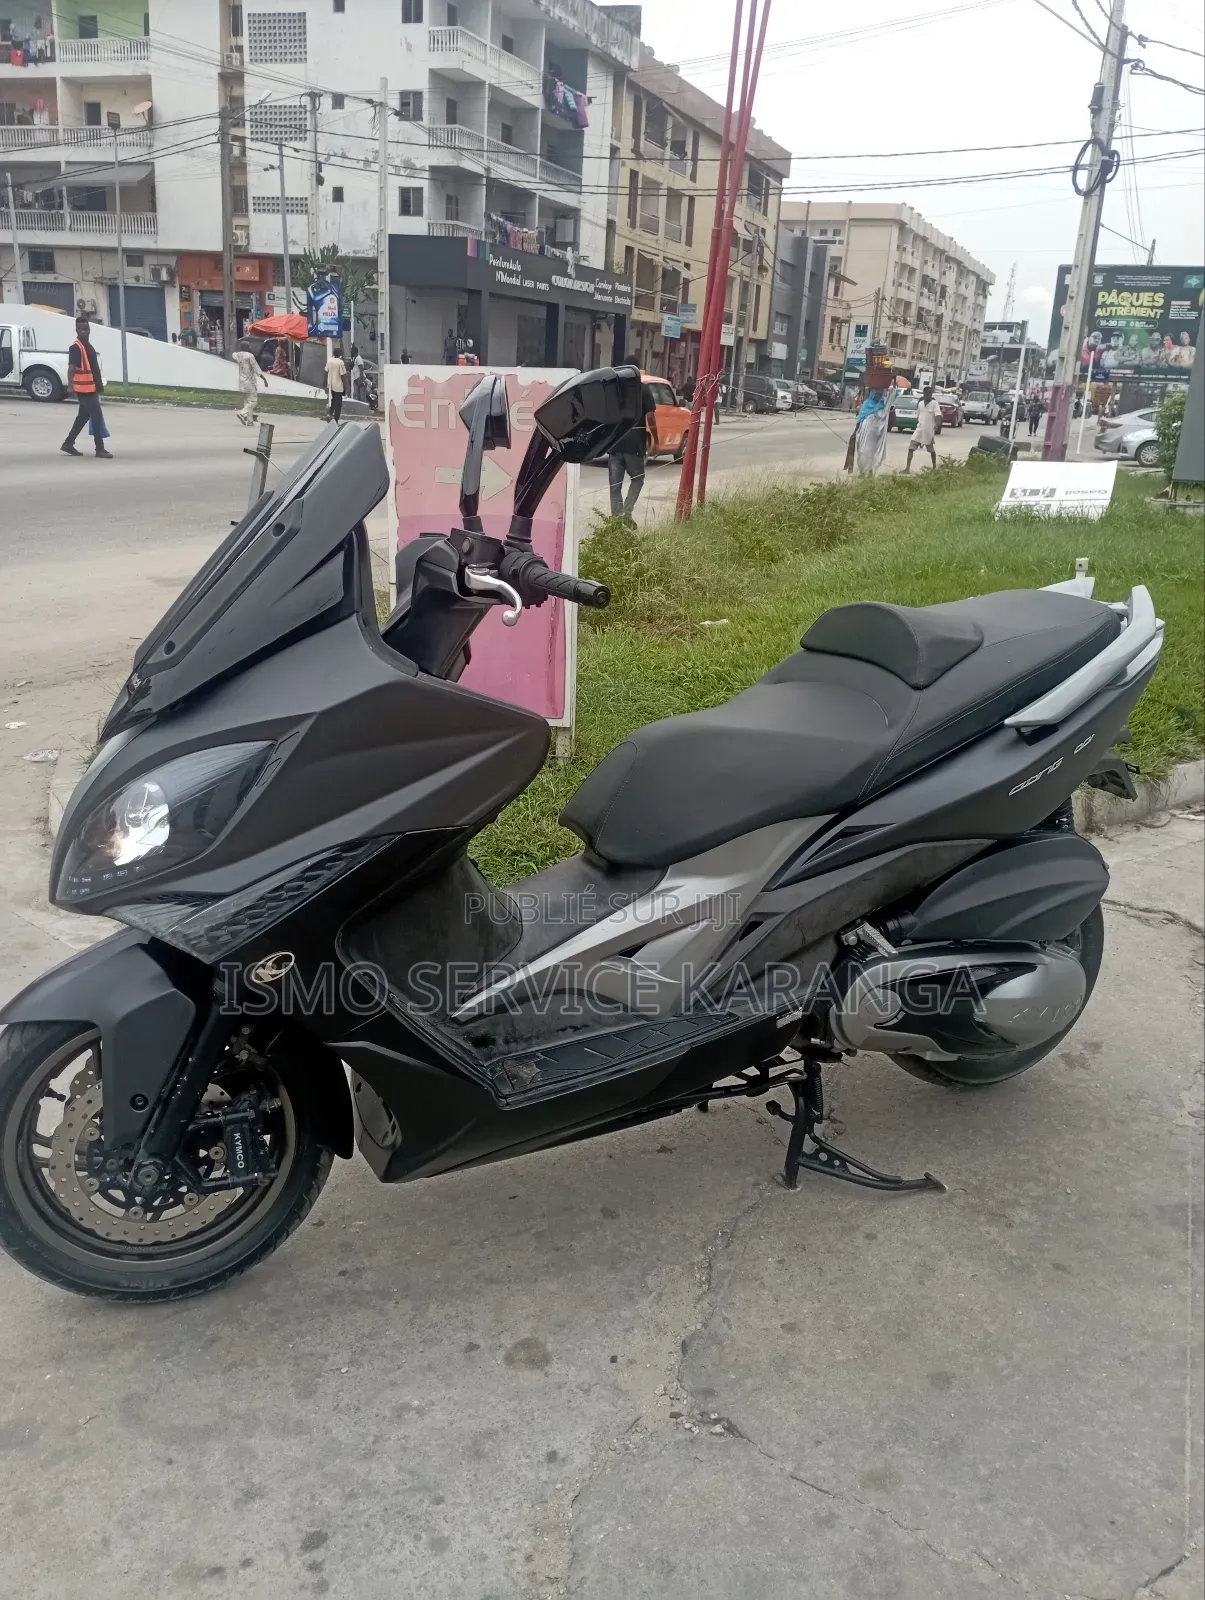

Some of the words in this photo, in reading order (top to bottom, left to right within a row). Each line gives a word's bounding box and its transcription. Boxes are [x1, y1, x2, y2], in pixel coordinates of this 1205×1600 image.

[1097, 289, 1165, 307] PÂQUES
[1094, 306, 1164, 318] AUTREMENT
[233, 1132, 245, 1169] KYMCO
